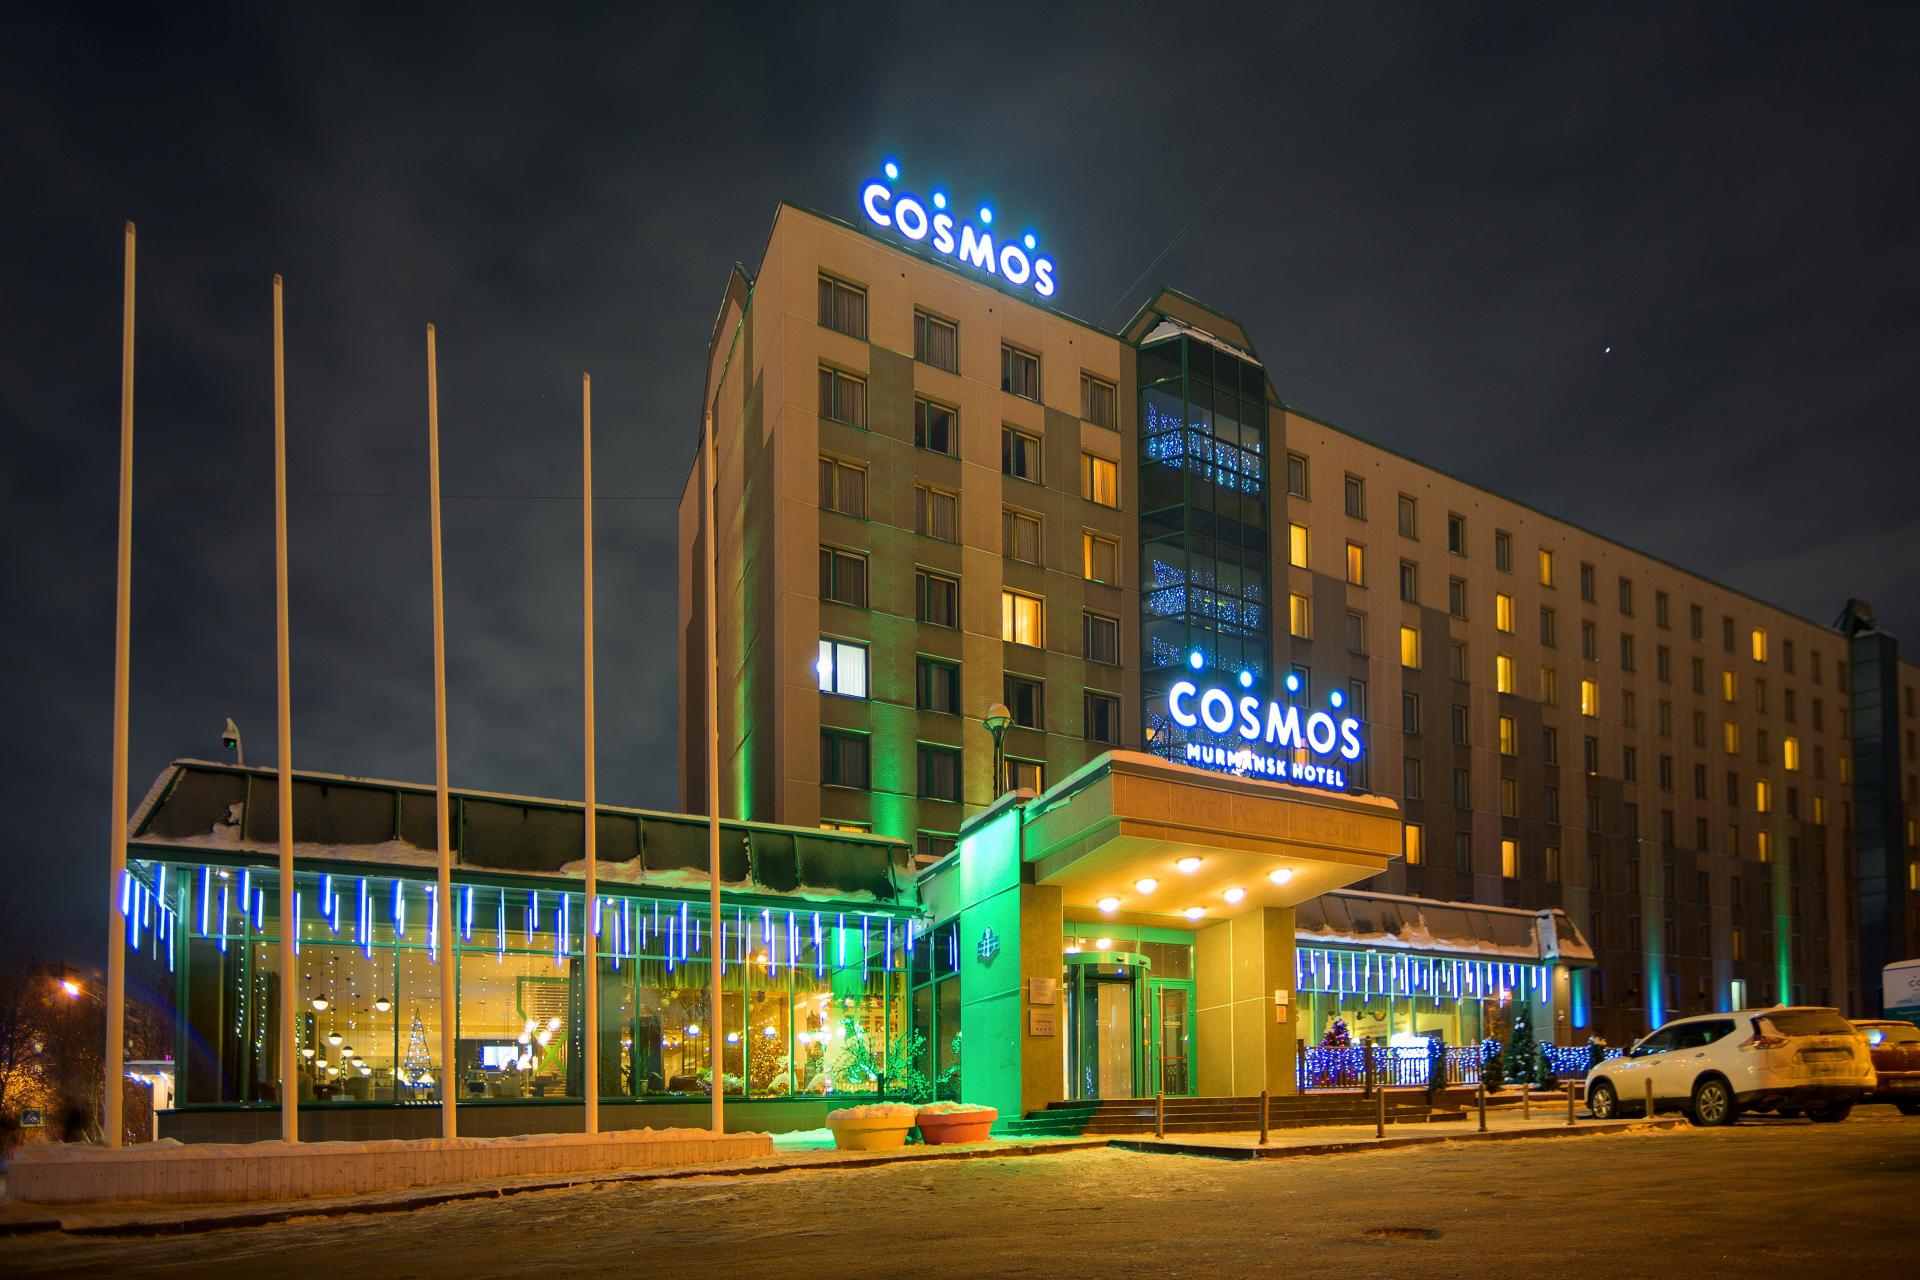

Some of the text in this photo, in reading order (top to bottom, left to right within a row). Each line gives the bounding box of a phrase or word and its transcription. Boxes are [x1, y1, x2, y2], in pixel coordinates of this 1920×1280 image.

[862, 183, 1055, 297] COSMOS
[1168, 681, 1361, 759] COSMOS
[1186, 743, 1344, 787] MURMANSK HOTEL
